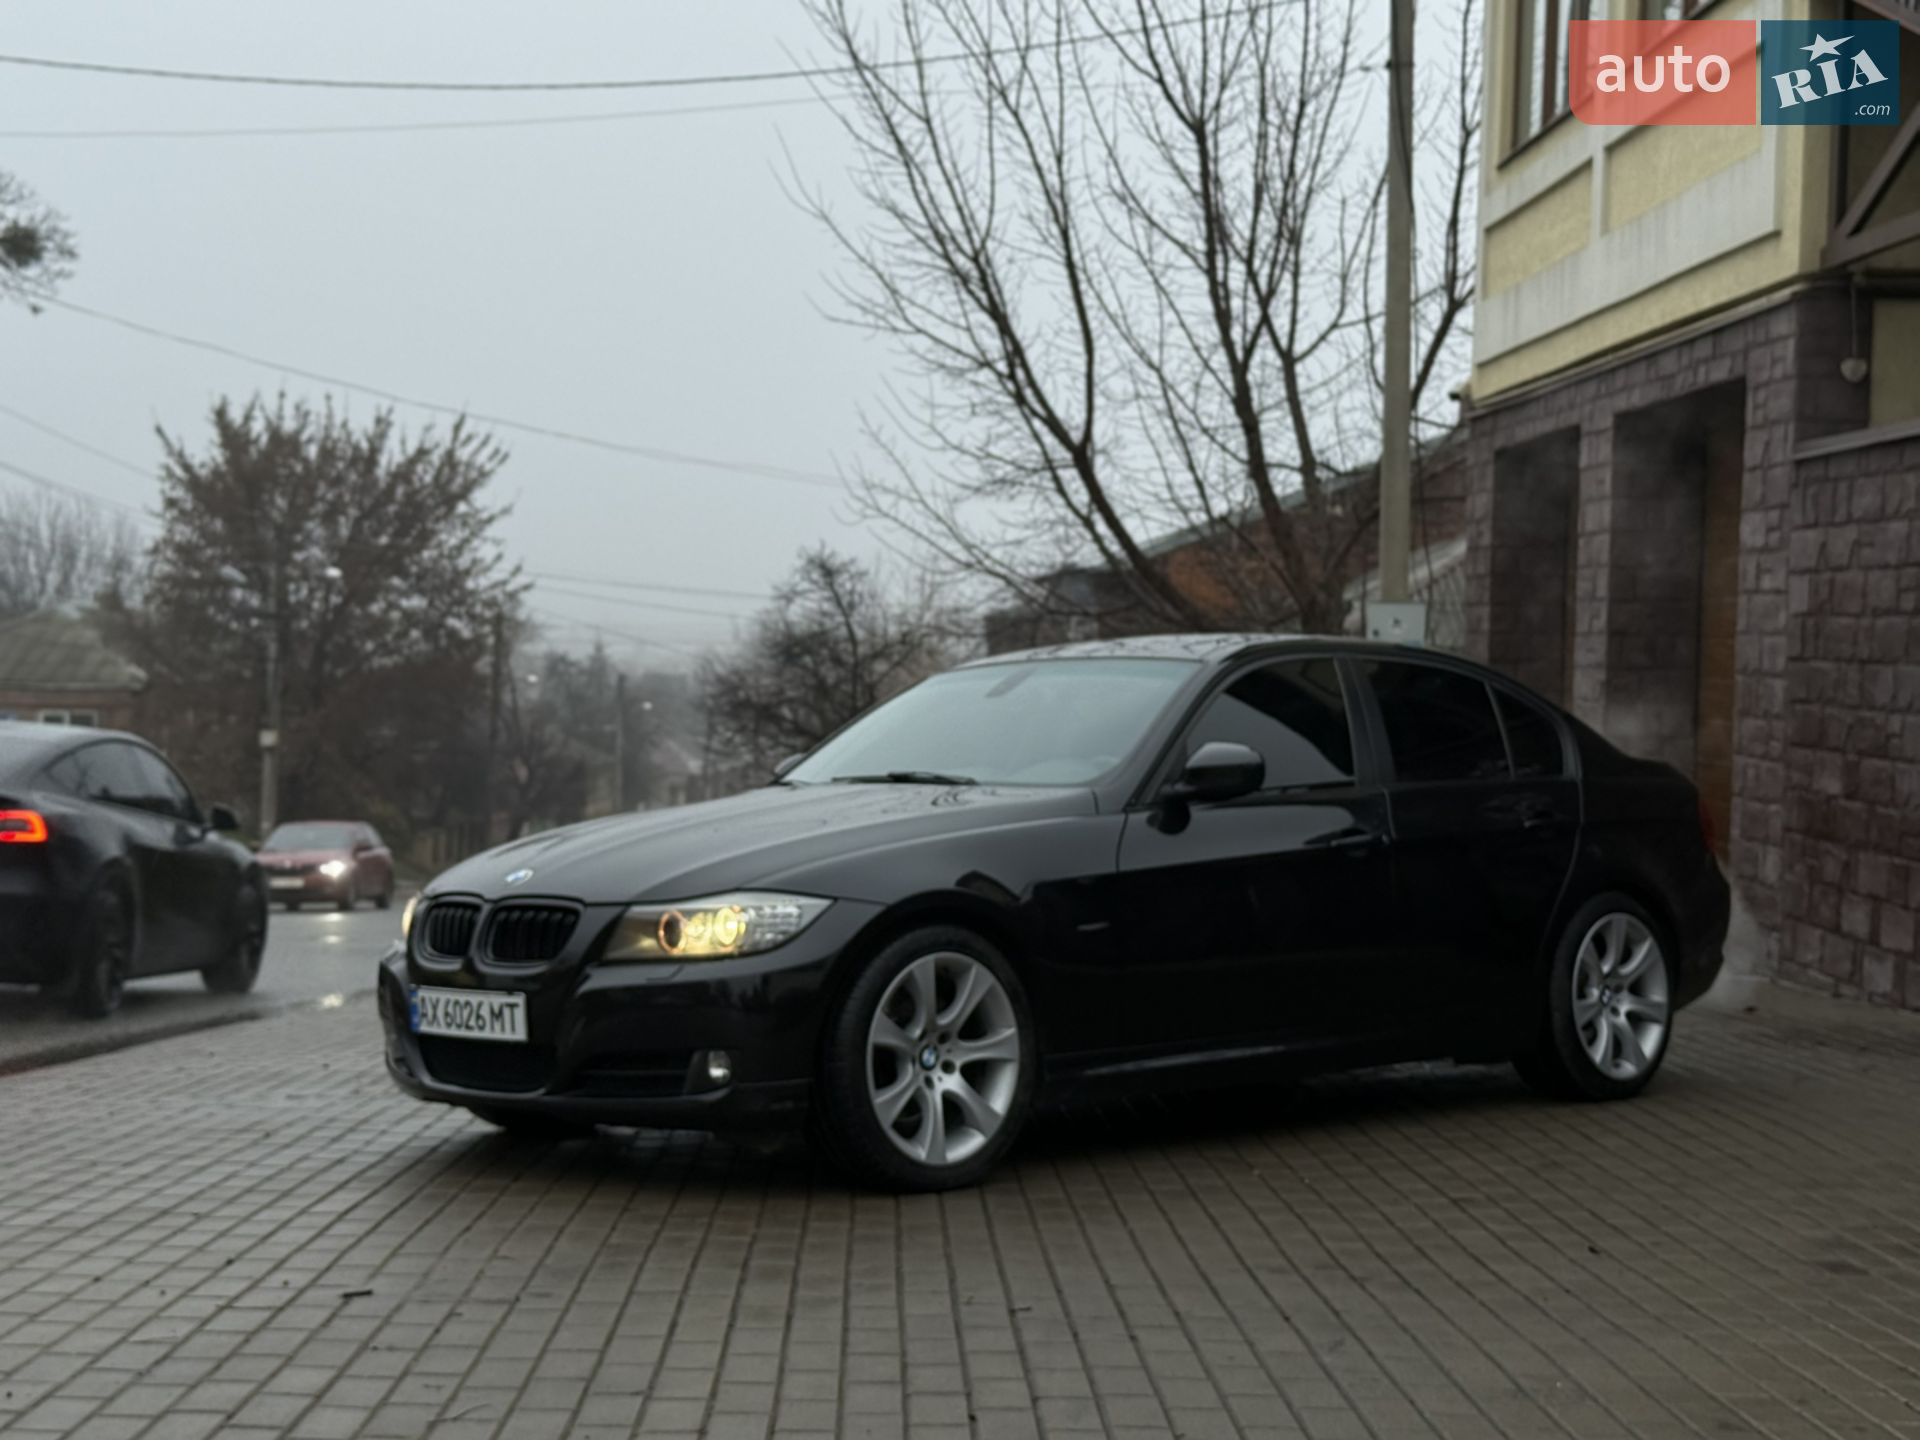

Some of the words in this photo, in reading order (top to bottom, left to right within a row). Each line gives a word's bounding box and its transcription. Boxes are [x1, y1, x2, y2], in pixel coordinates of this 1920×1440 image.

[420, 995, 442, 1028] AX
[444, 997, 487, 1031] 6026
[489, 1001, 520, 1034] MT
